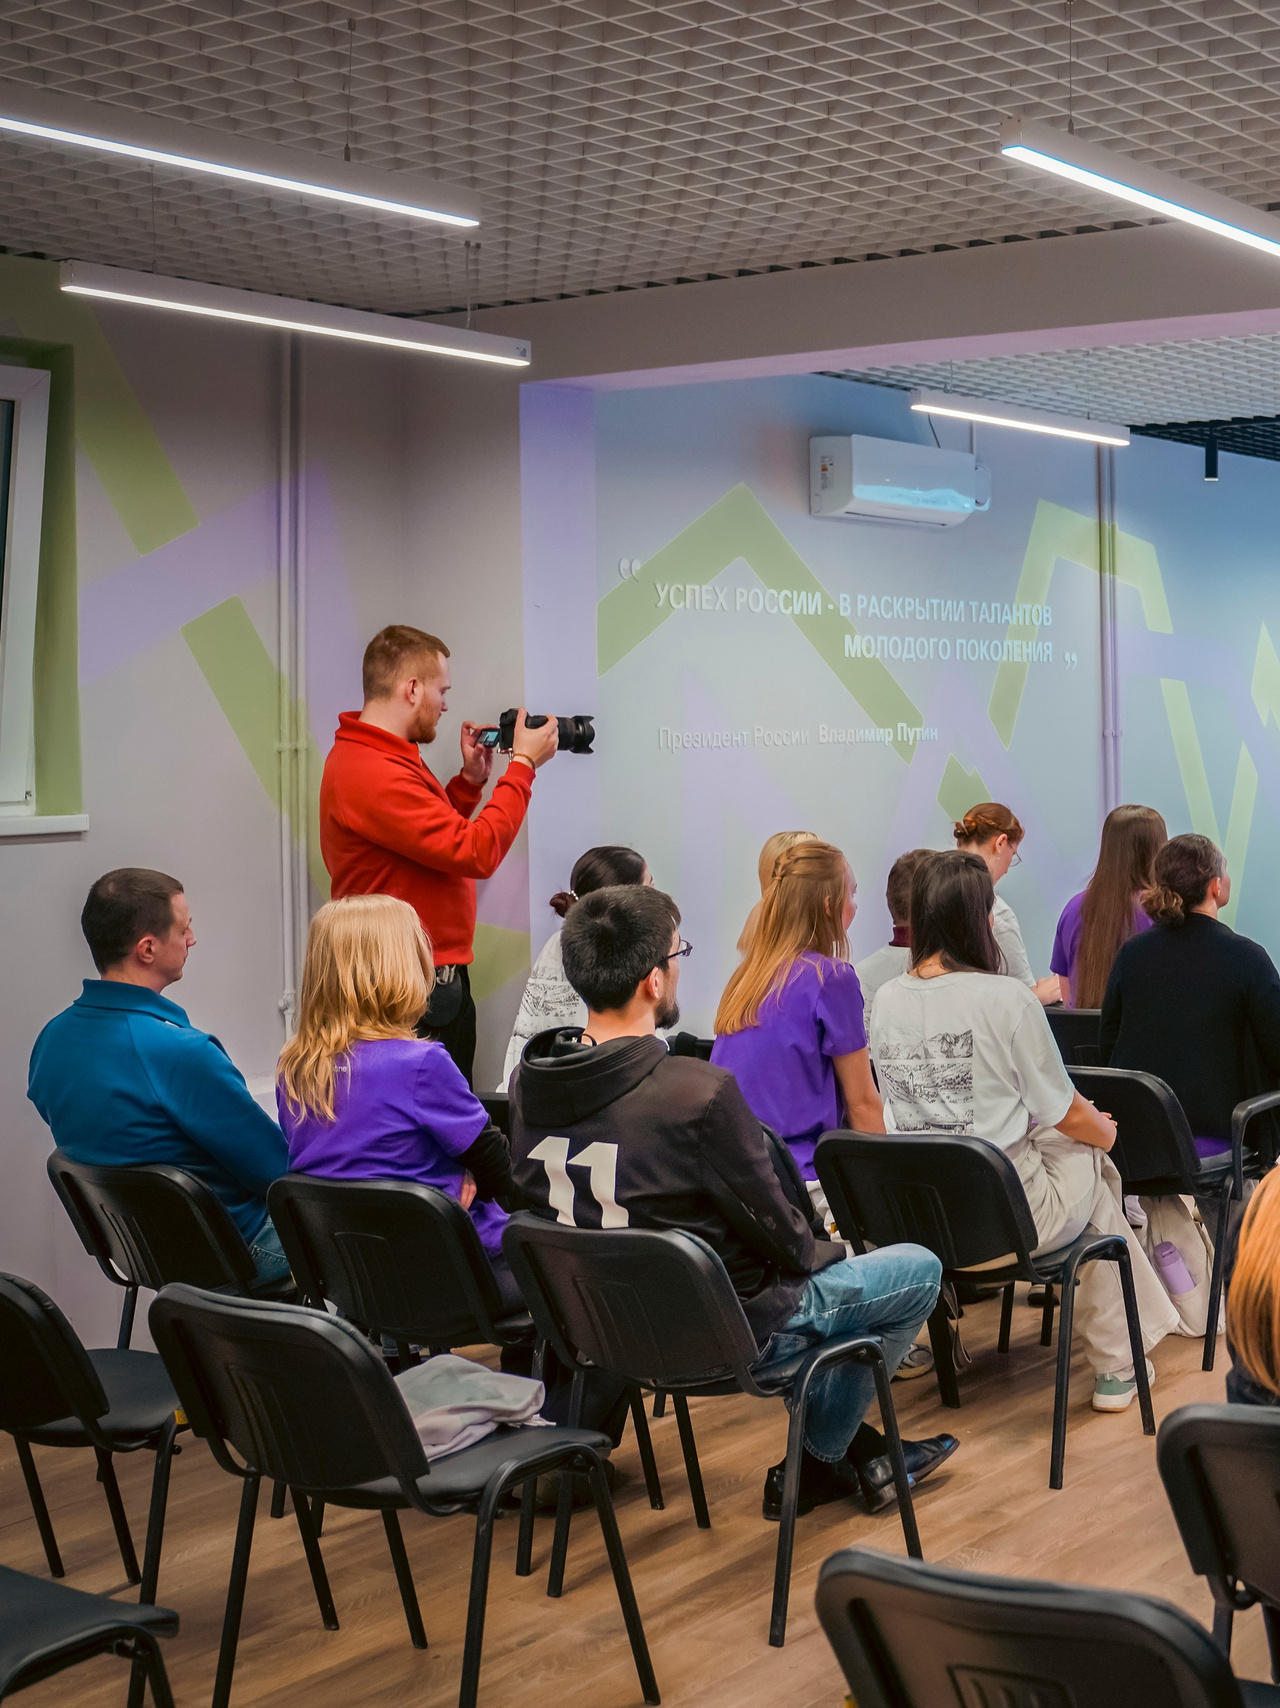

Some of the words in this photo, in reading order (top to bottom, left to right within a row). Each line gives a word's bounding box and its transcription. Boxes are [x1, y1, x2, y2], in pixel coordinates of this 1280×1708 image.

[654, 583, 728, 611] УСПЕХ
[736, 588, 822, 615] РОССИИ
[839, 593, 851, 617] В
[857, 594, 965, 622] РАСКРЫТИИ
[969, 601, 1053, 626] ТАЛАНТОВ
[844, 634, 950, 663] МОЛОДОГО
[956, 639, 1053, 662] ПОКОЛЕНИЯ
[659, 727, 749, 753] Президент
[753, 725, 809, 747] России
[818, 724, 893, 745] Владимир
[897, 722, 939, 745] Путин
[527, 1135, 630, 1230] 11
